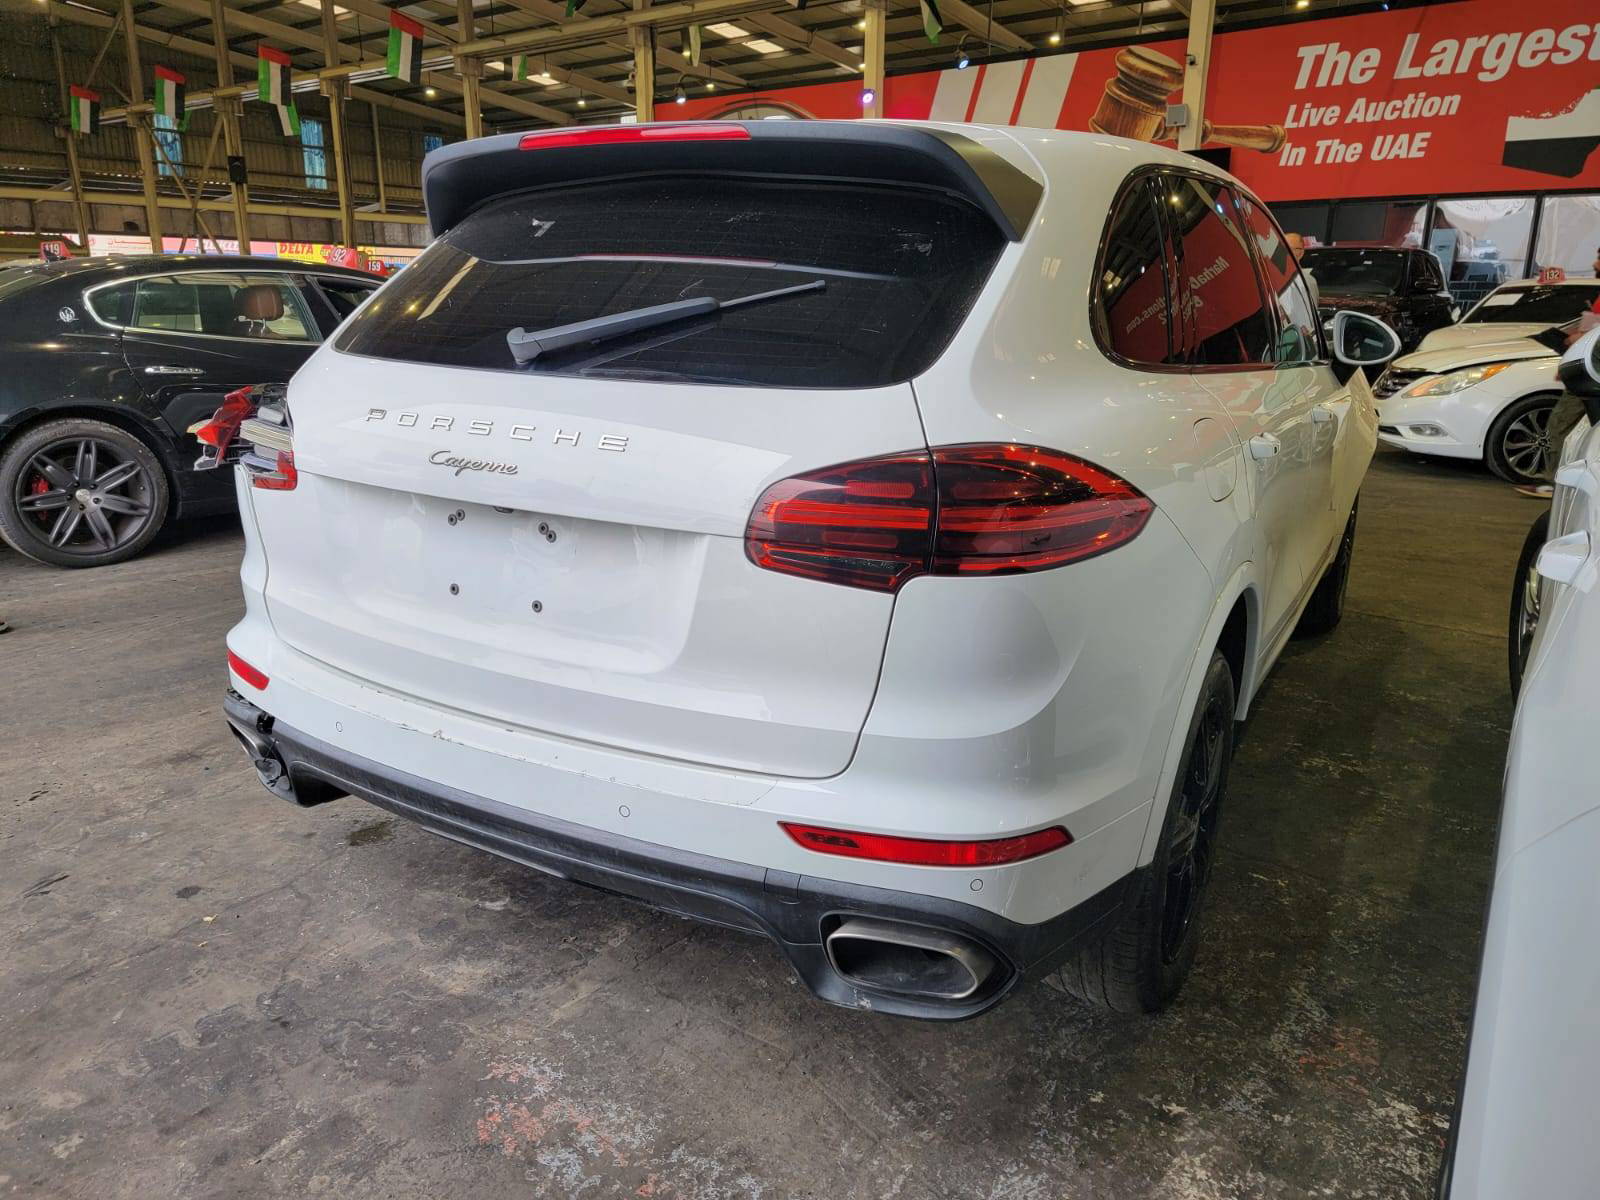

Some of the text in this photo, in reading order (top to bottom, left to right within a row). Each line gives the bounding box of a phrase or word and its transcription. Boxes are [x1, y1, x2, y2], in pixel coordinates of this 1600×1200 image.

[1294, 22, 1600, 90] The Largest
[1284, 92, 1461, 129] Live Auction
[1279, 131, 1432, 166] In The UAE
[279, 242, 314, 255] DELTA
[332, 248, 347, 263] 92
[1546, 269, 1560, 280] 132
[366, 408, 629, 452] PORSCHE
[428, 450, 519, 476] Cayenne
